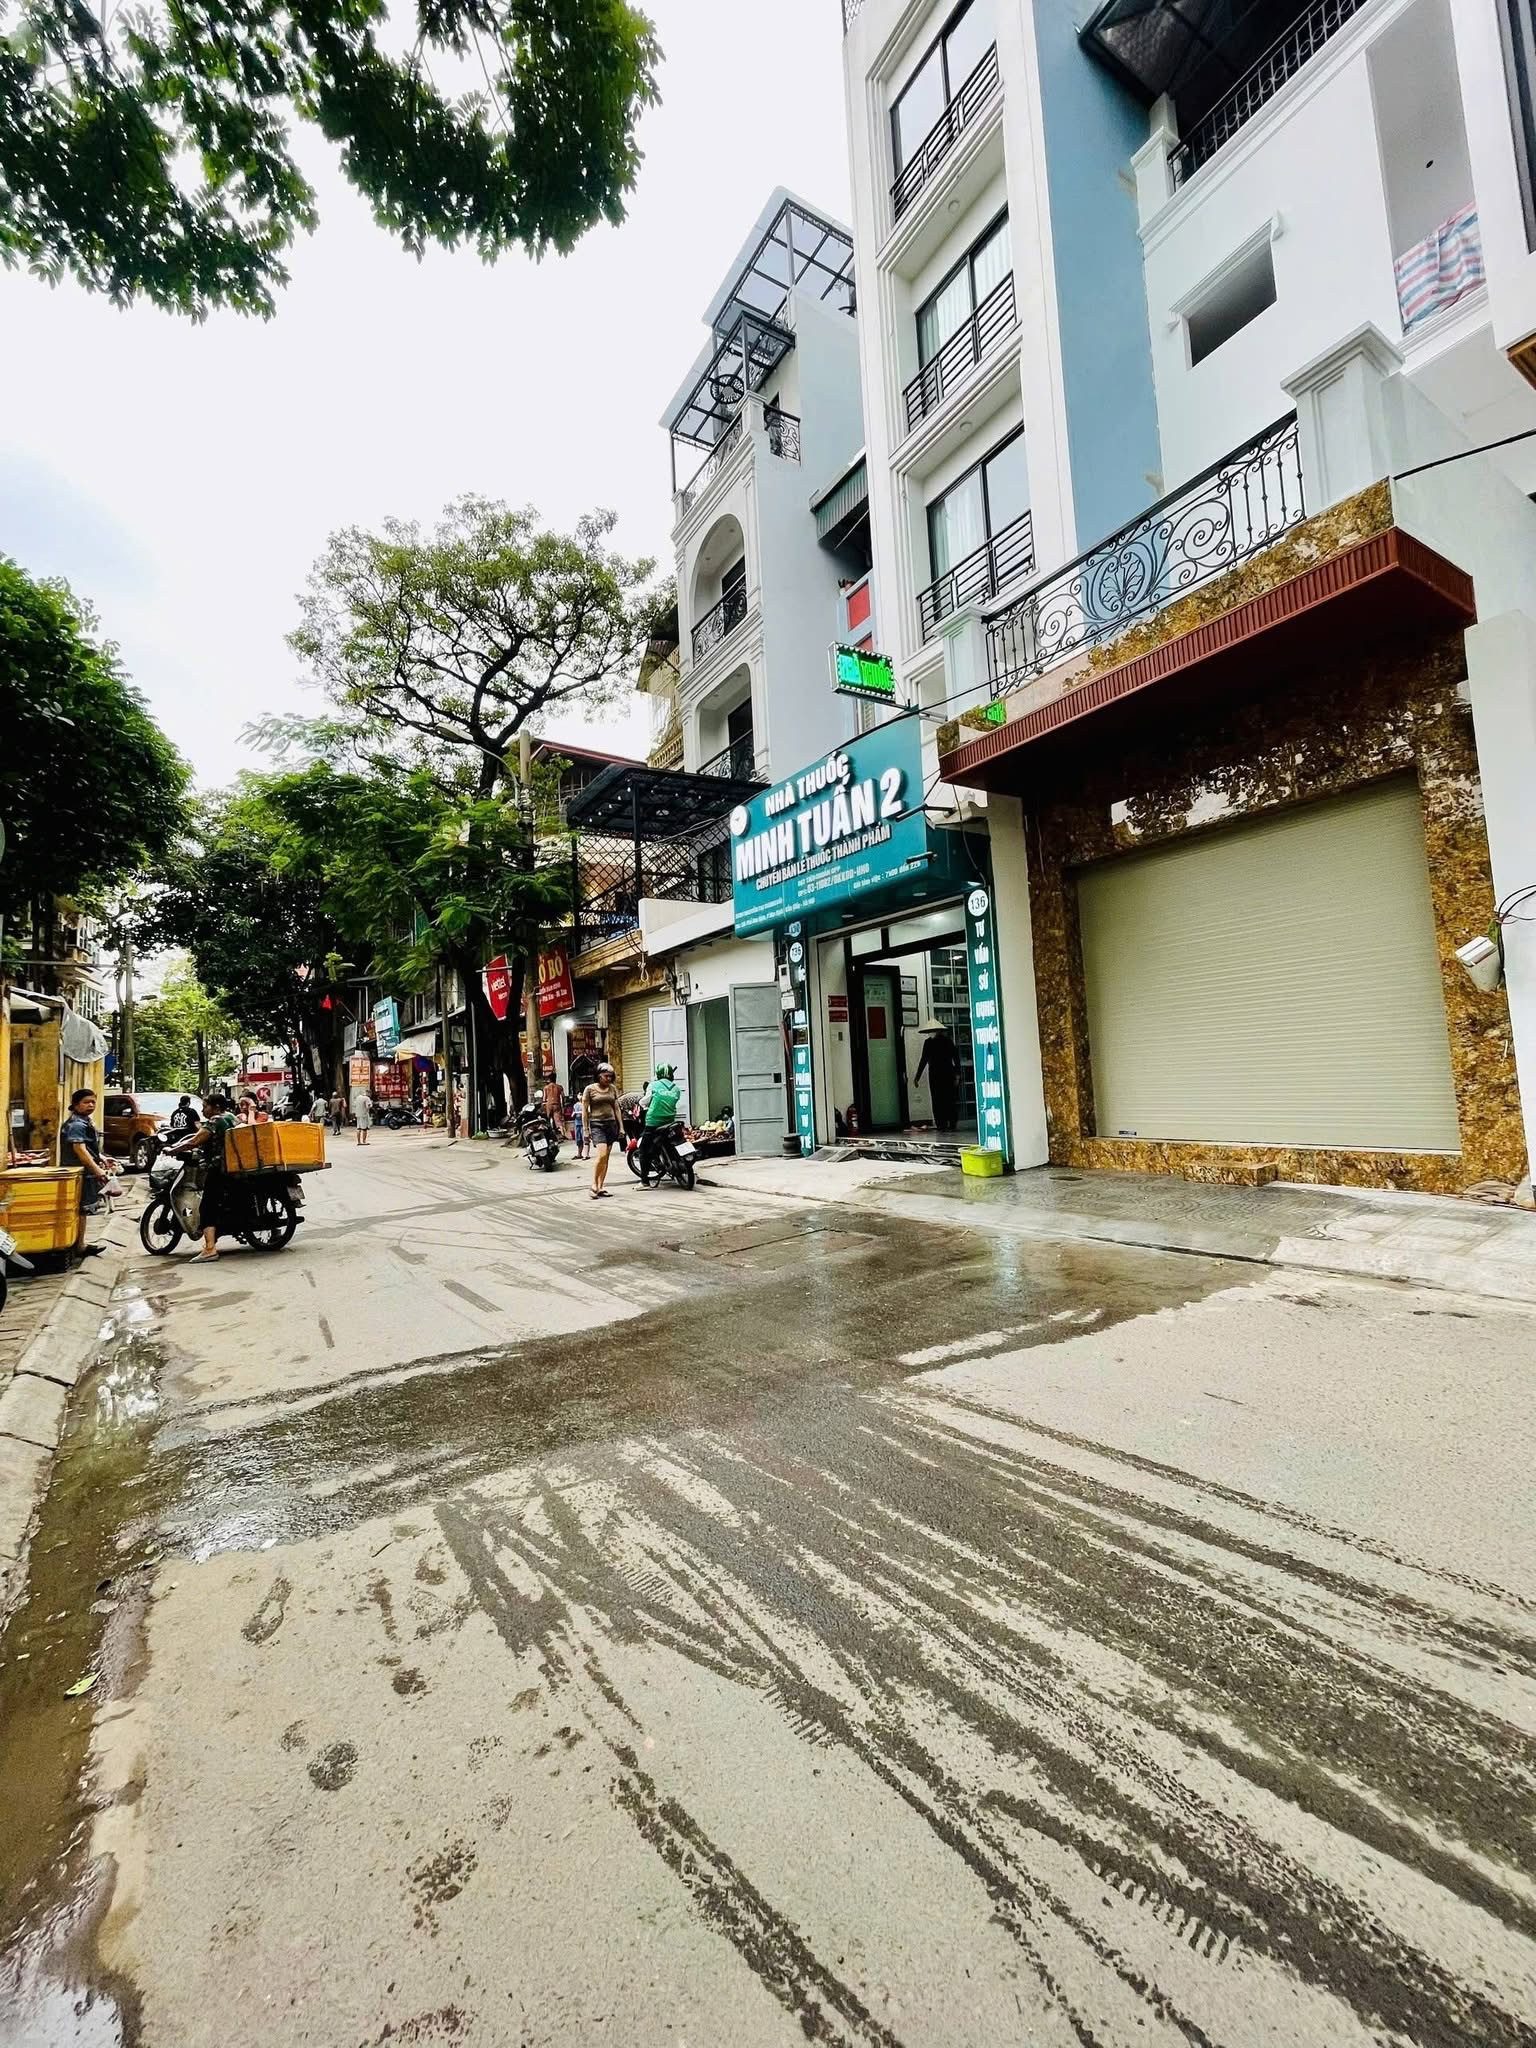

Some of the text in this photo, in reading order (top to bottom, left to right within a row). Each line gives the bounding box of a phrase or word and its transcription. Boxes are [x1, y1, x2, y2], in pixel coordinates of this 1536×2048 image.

[860, 658, 892, 692] THUỐC
[765, 751, 849, 816] NHÀ THUỐC
[736, 768, 902, 881] MINH TUẤN 2
[783, 862, 797, 880] BÁN
[806, 848, 831, 869] THUỐC
[832, 837, 861, 859] THÀNH
[971, 895, 986, 911] 136
